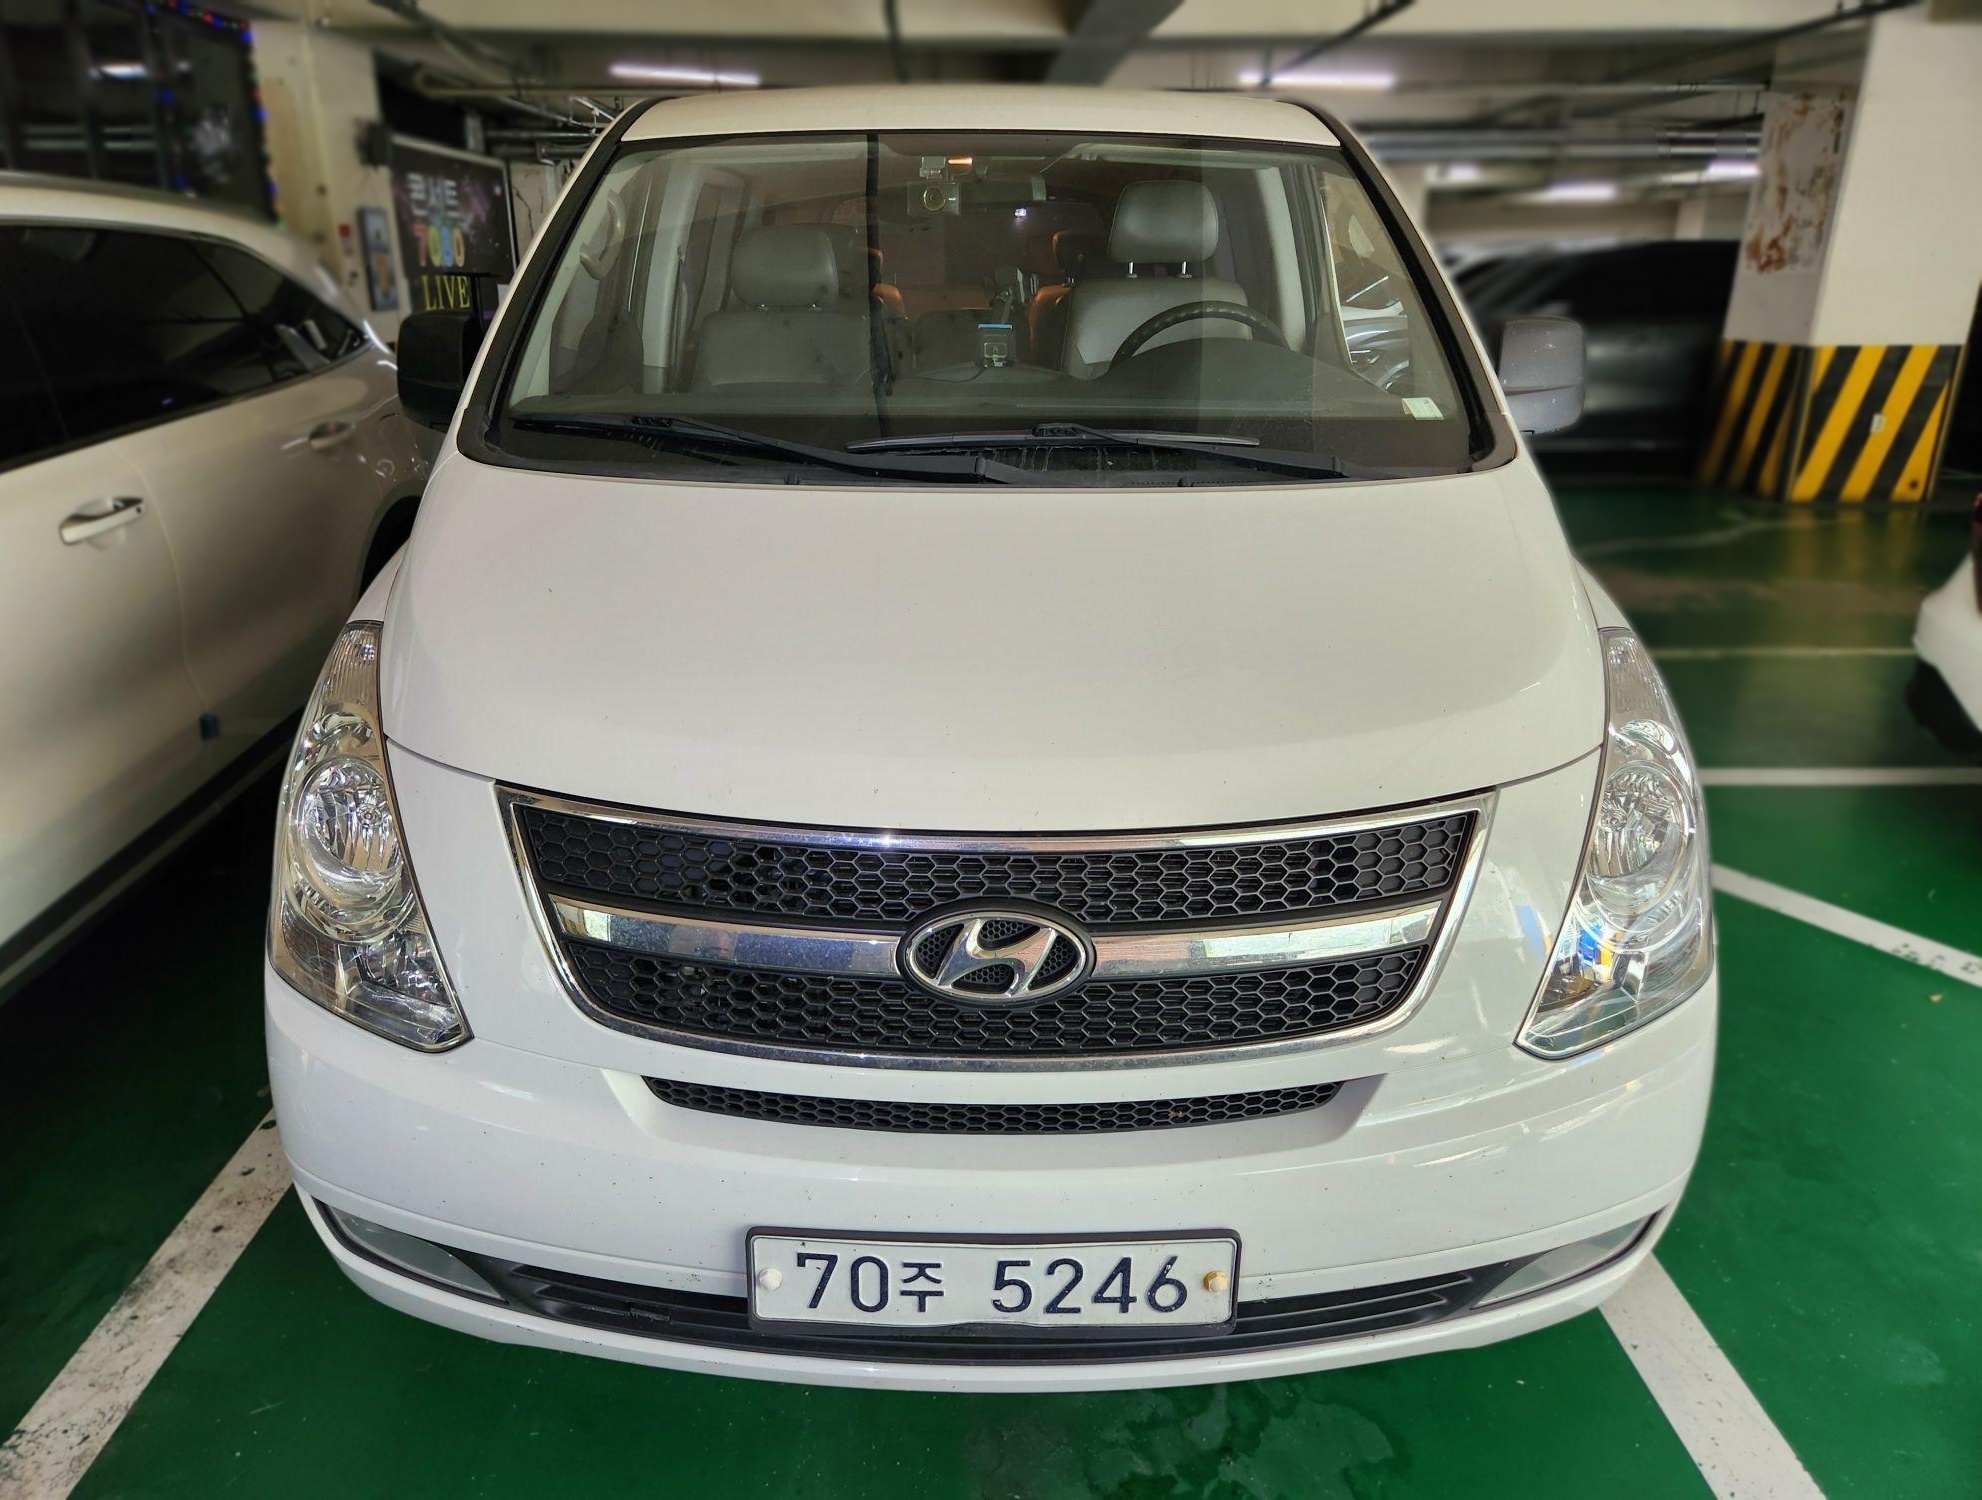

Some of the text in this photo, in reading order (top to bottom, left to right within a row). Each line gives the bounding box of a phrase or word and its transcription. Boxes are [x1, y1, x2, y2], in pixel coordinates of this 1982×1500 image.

[421, 274, 471, 311] LIVE
[796, 1252, 1189, 1314] 70주 5246
